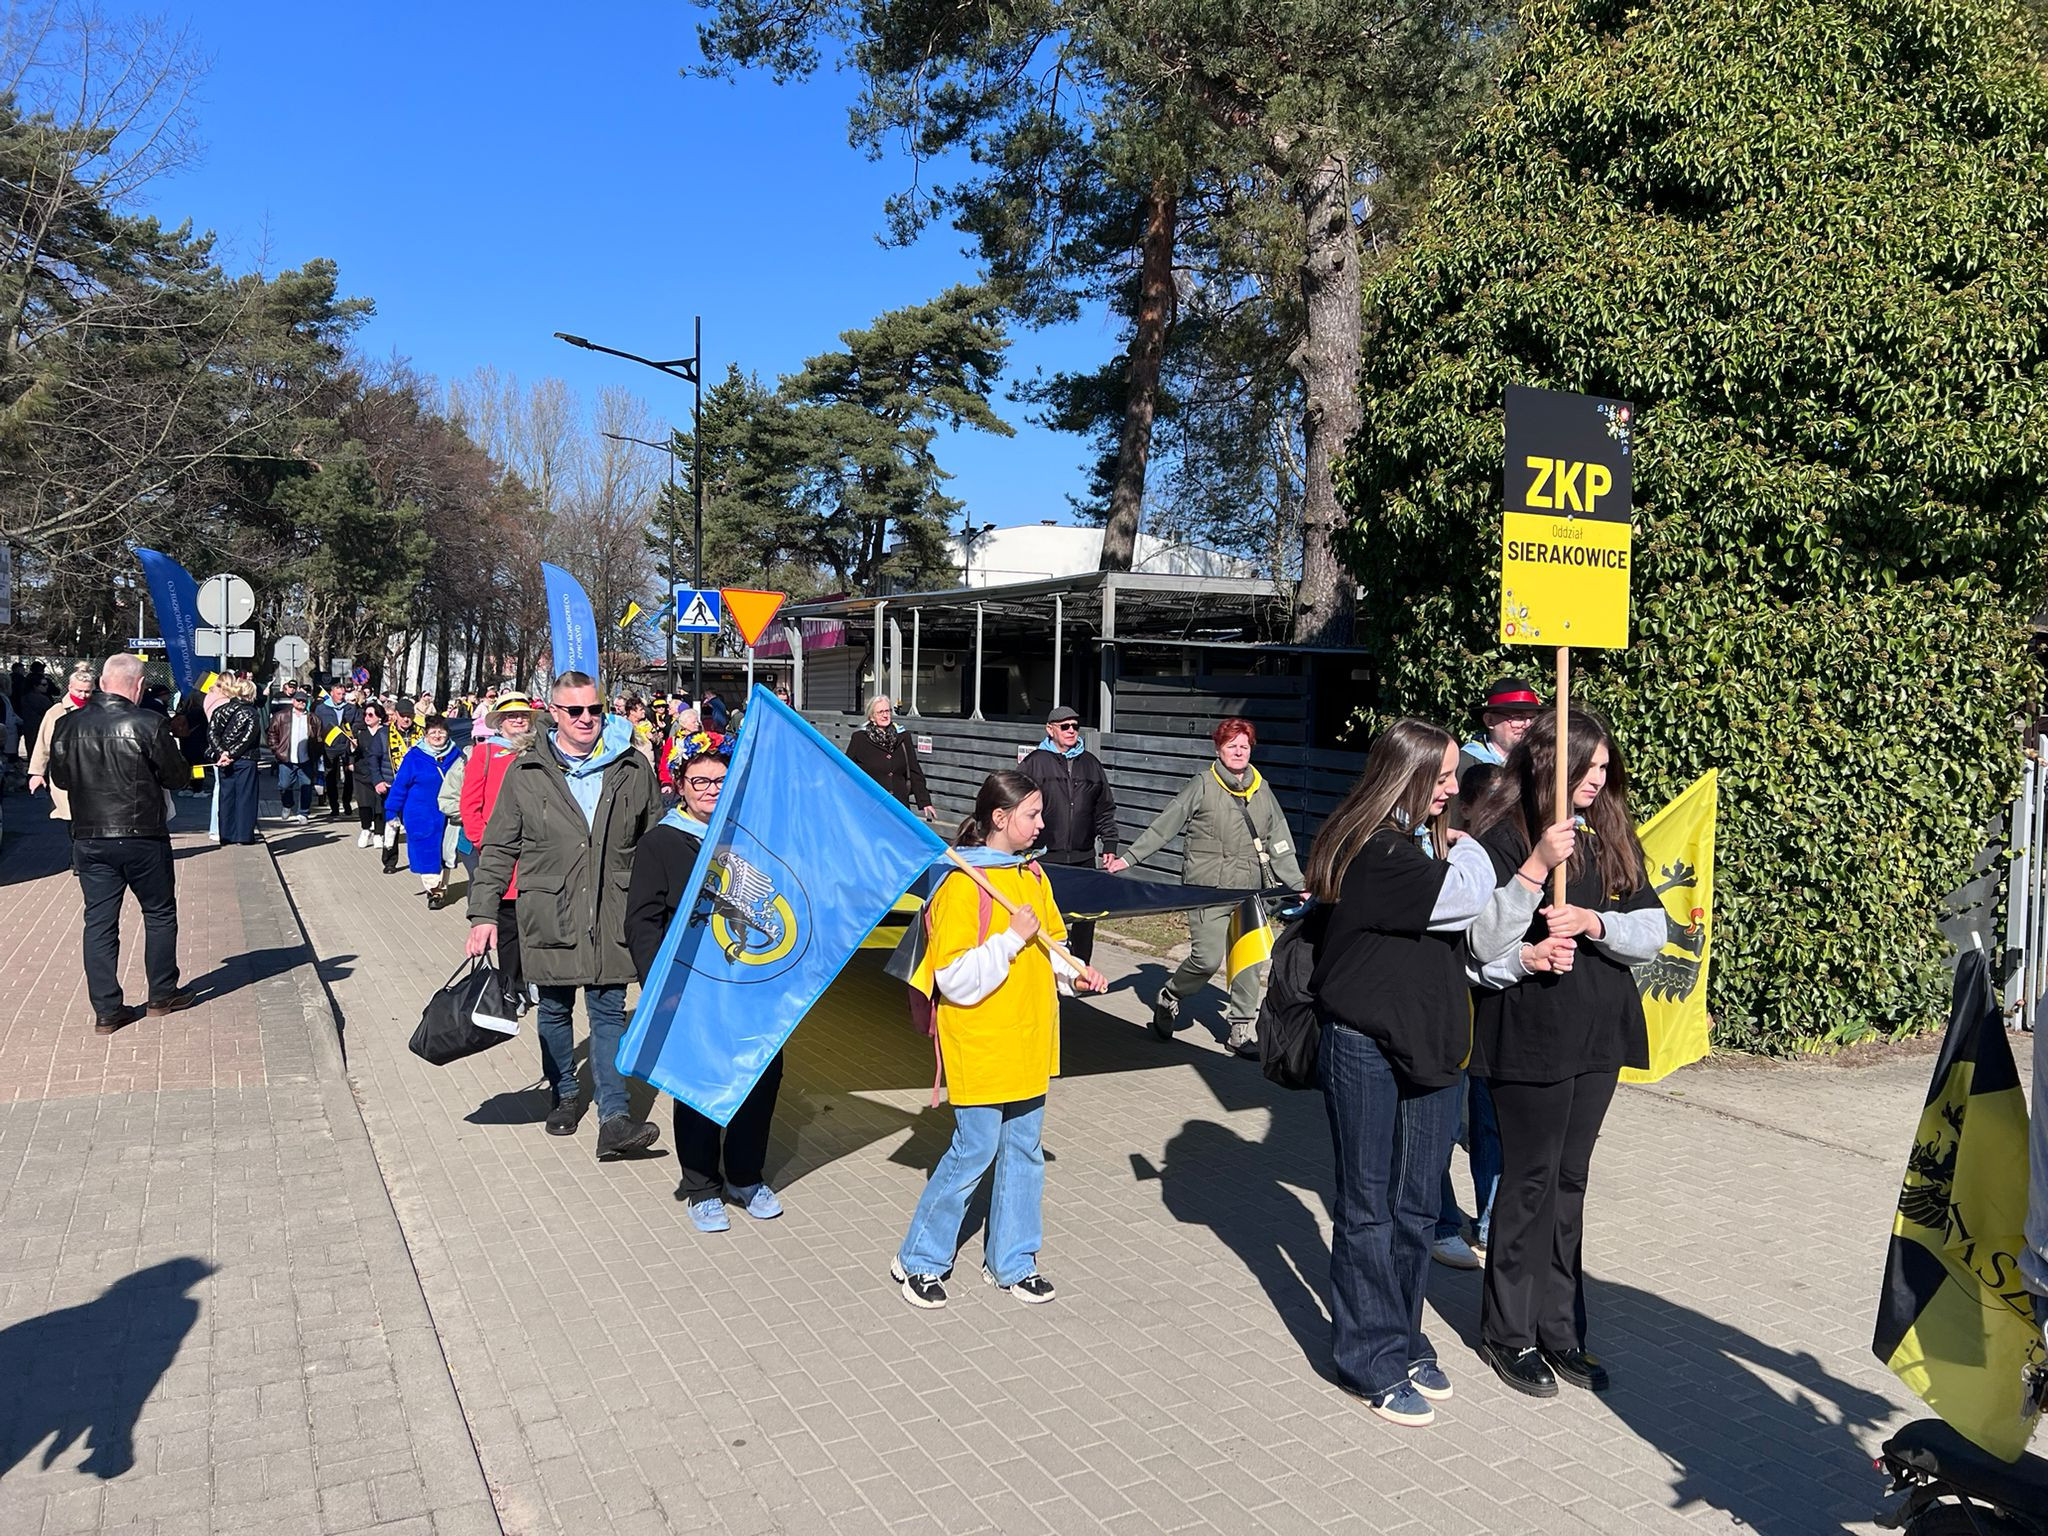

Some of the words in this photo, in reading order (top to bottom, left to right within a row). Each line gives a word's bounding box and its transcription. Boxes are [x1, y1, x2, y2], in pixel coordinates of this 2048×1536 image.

[1525, 455, 1613, 513] ZKP
[1552, 524, 1584, 540] Oddział
[1507, 540, 1628, 570] SIERAKOWICE
